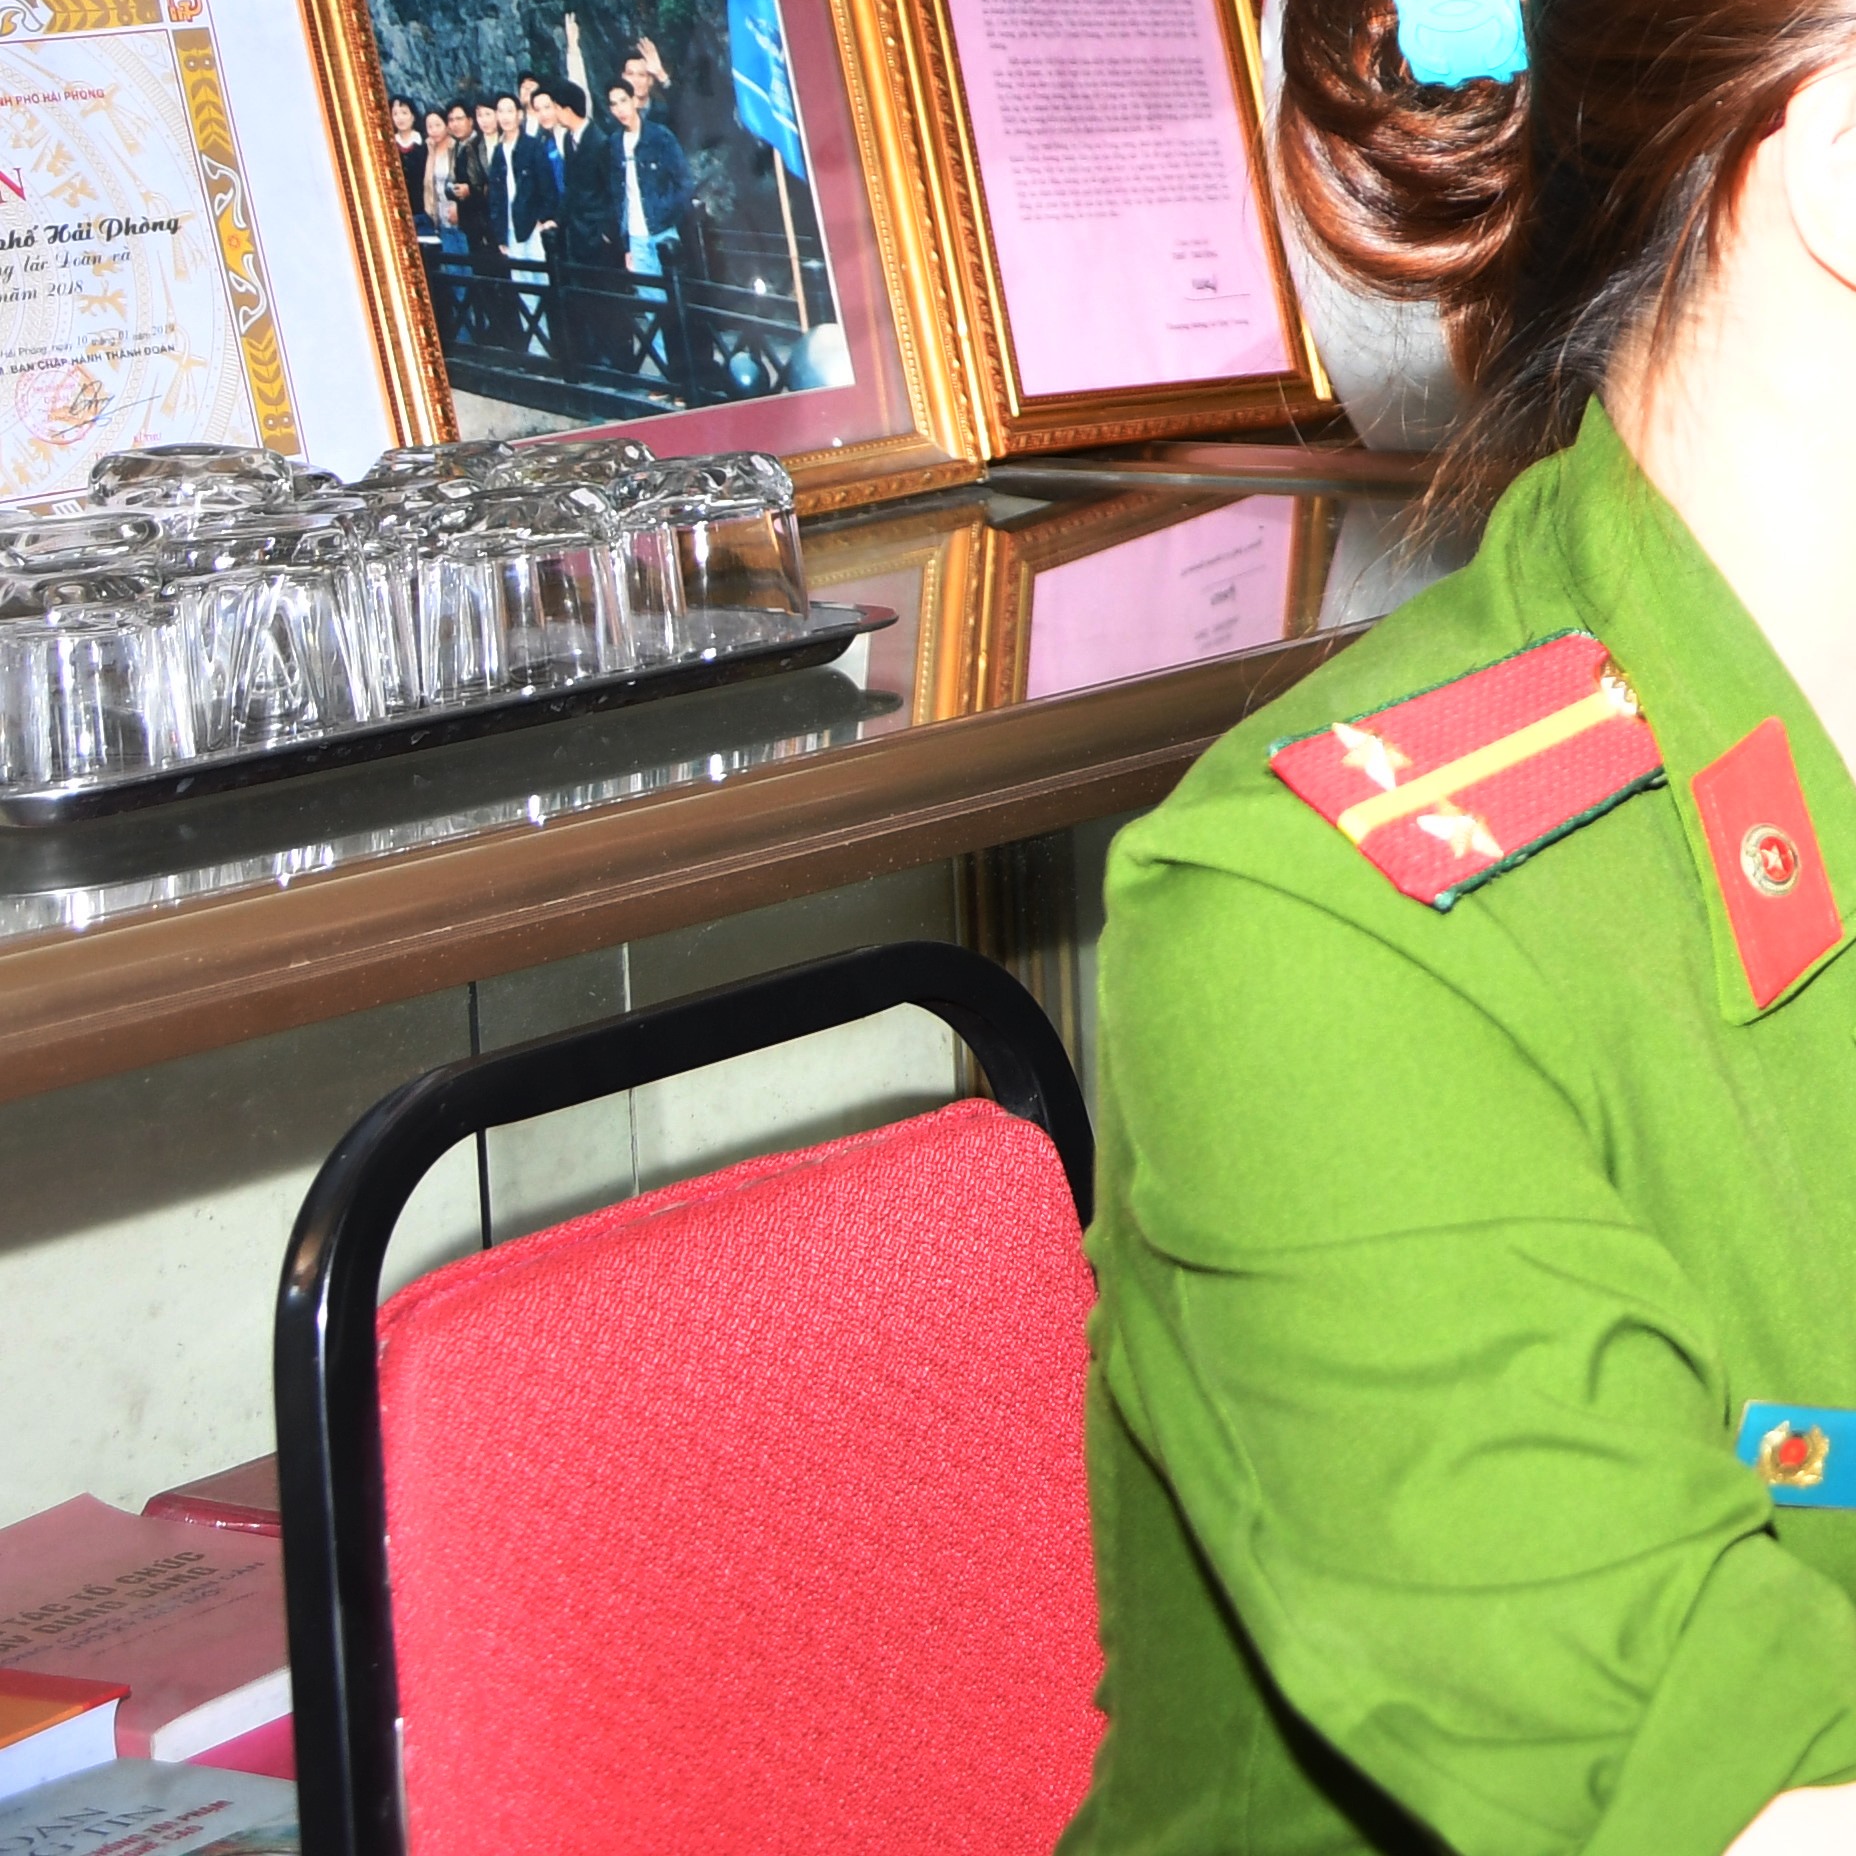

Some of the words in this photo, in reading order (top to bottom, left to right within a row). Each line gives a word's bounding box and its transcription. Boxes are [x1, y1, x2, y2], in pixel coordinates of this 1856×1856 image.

[100, 216, 180, 242] Phòng
[48, 280, 83, 297] 2018
[77, 335, 87, 345] 10
[118, 330, 129, 340] 01
[151, 324, 175, 336] 2019
[10, 362, 35, 375] BAN
